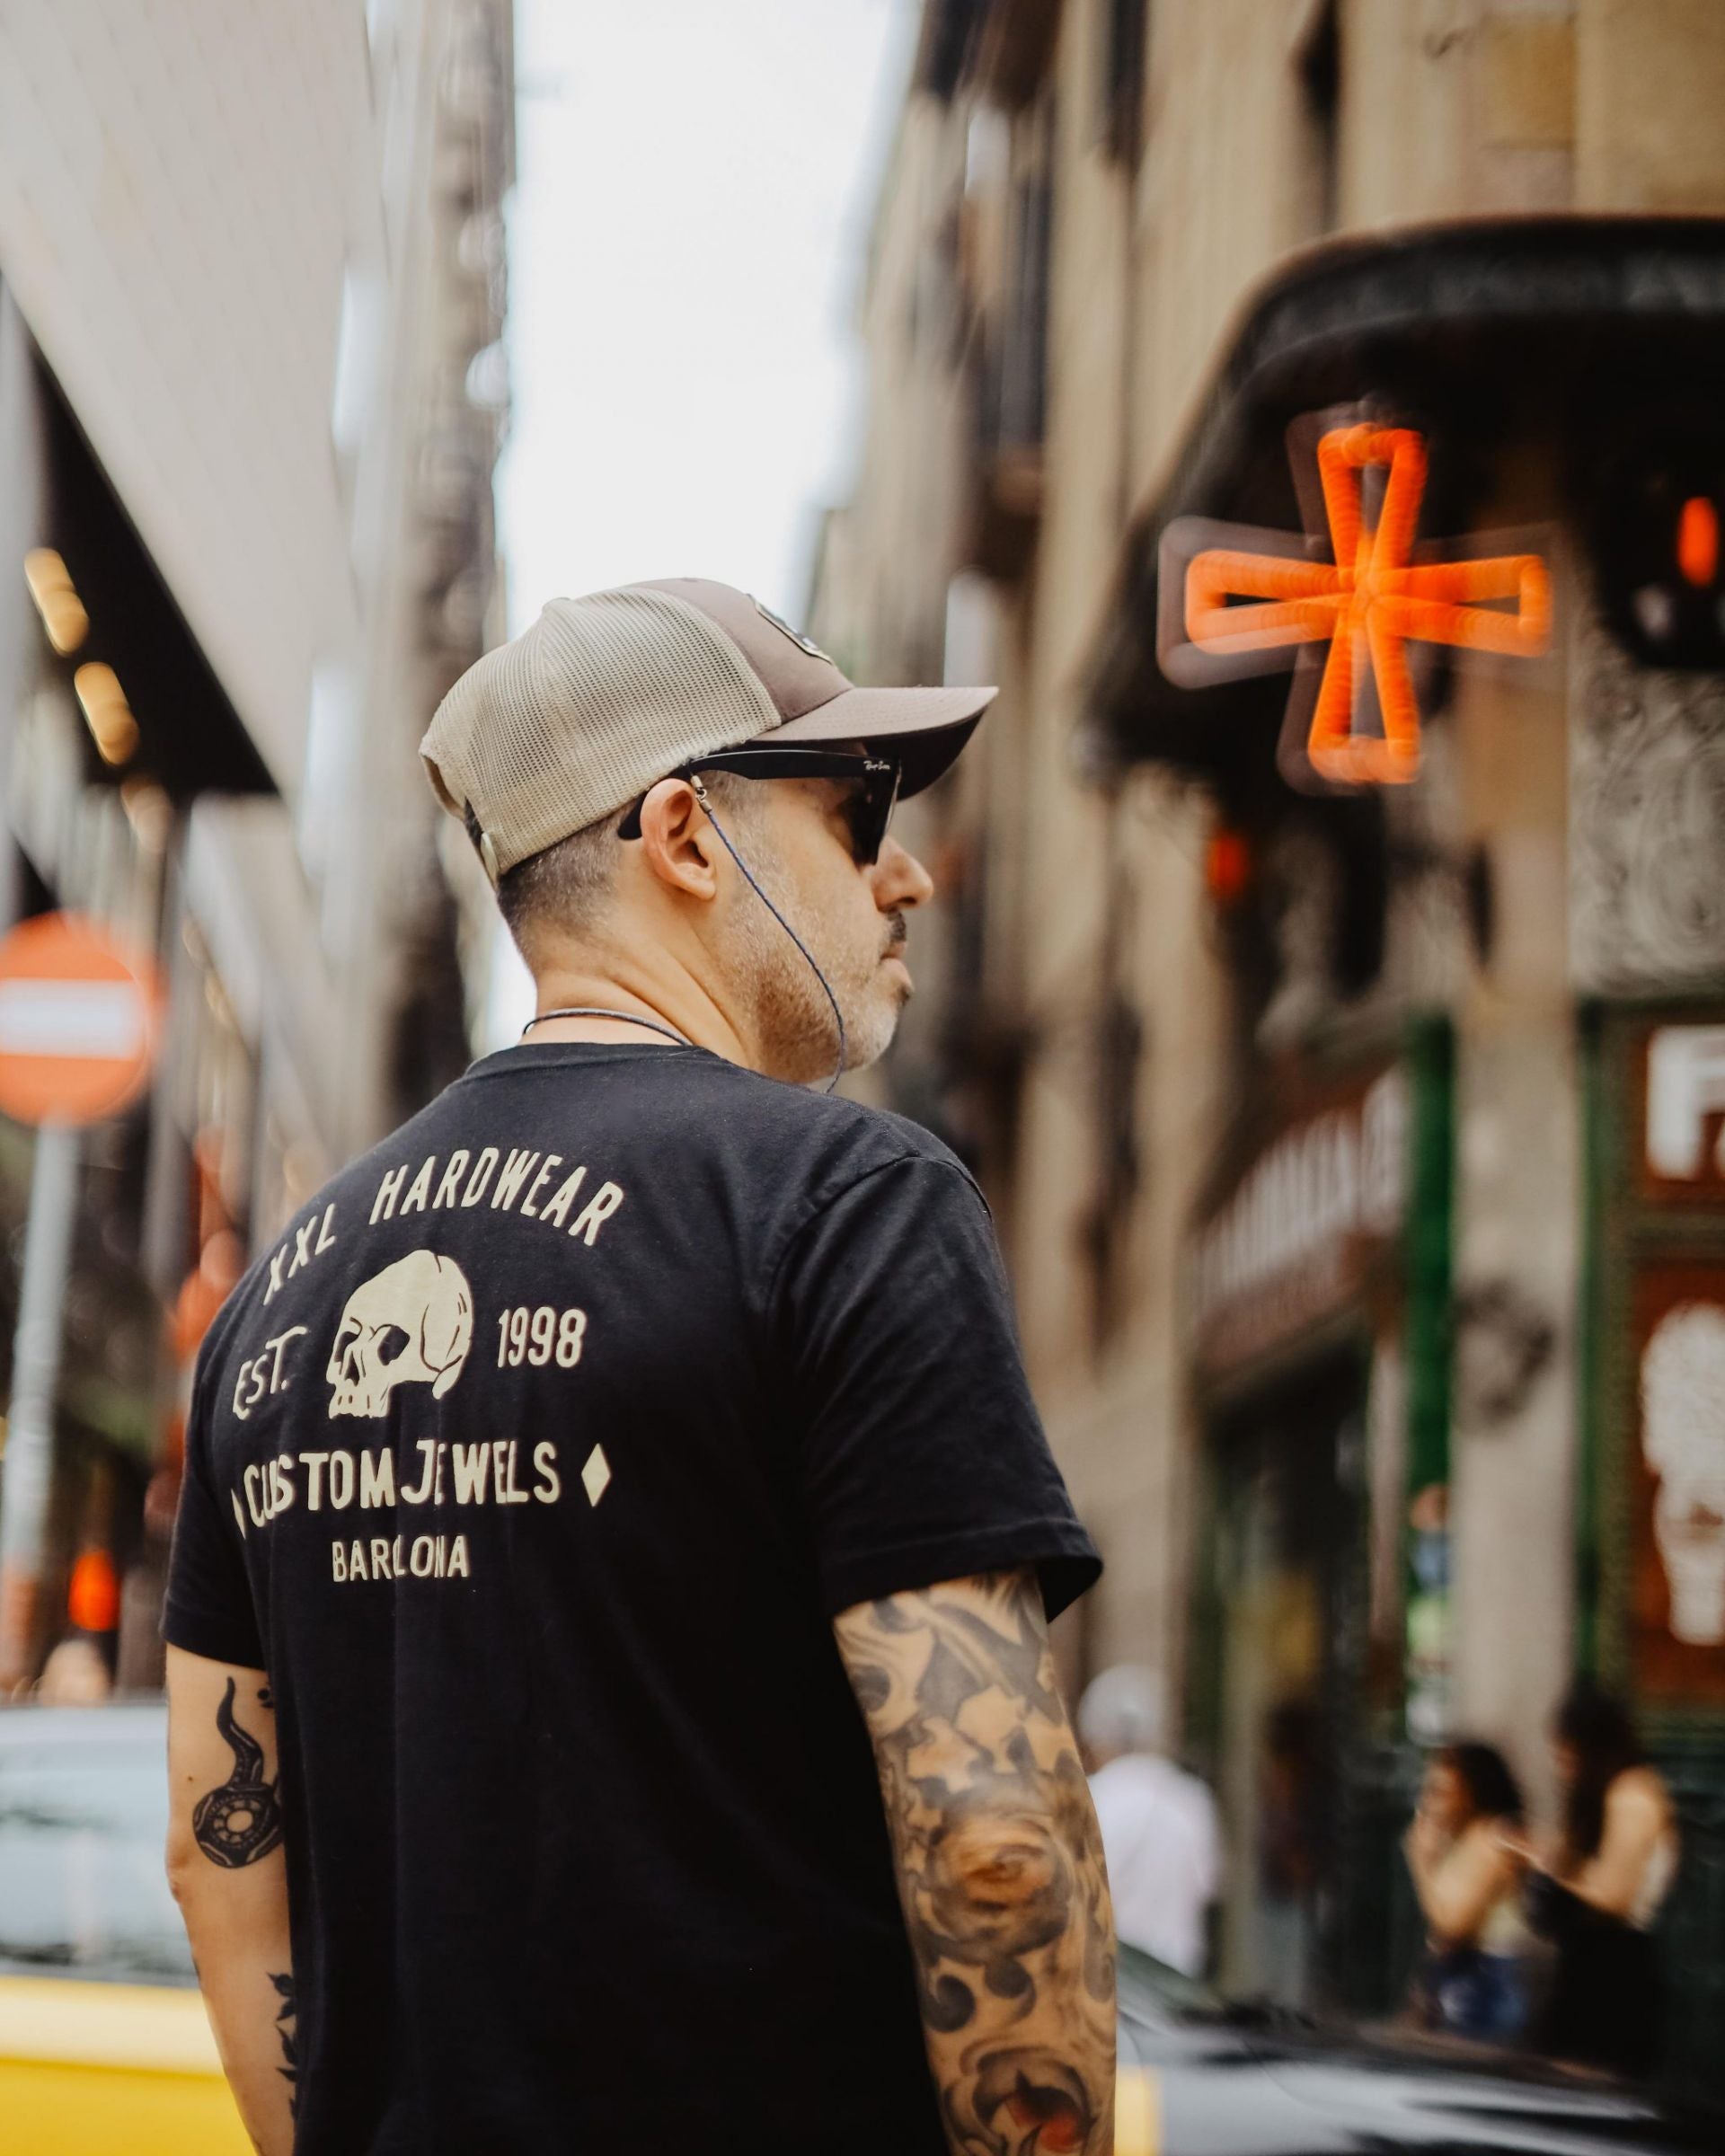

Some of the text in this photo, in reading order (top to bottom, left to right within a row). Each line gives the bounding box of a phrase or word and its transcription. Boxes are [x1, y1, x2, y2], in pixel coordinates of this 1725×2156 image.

[262, 1146, 625, 1306] XXL HARDWEAR
[231, 1306, 588, 1421] EST. 1998
[243, 1438, 561, 1529] CUSTOM JEWELS
